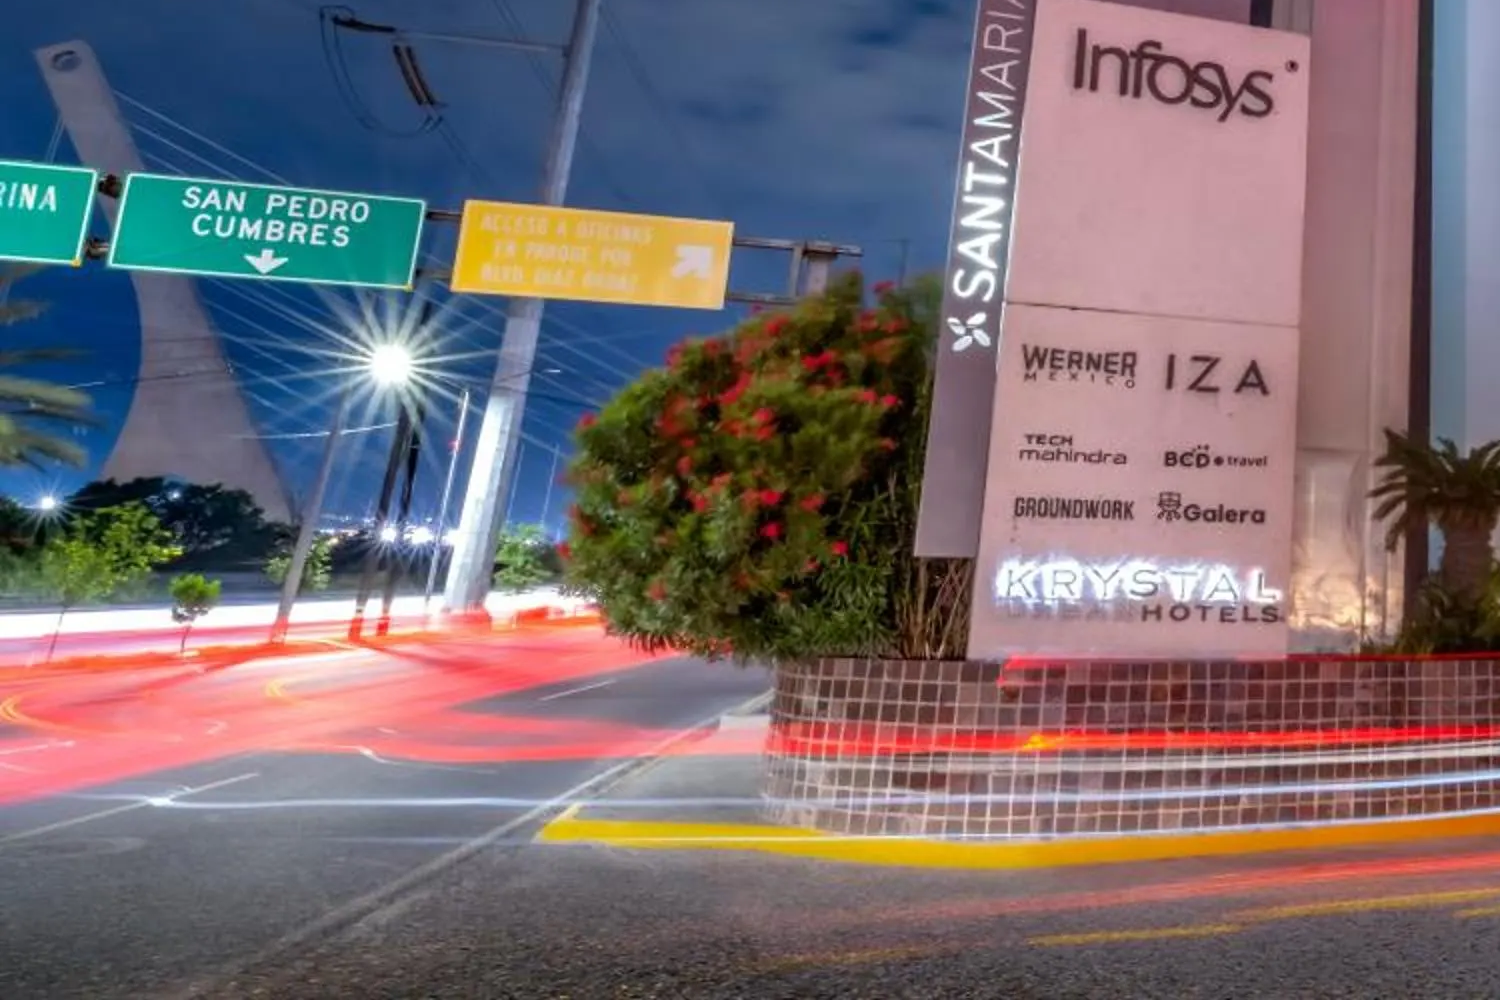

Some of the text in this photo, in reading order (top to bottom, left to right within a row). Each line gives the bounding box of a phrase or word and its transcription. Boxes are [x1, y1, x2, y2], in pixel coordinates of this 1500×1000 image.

[1073, 27, 1275, 123] Infosys
[182, 186, 371, 224] SAN PEDRO
[191, 213, 350, 248] CUMBRES
[1022, 344, 1138, 377] WERNER
[1165, 353, 1270, 395] IZA
[1024, 433, 1073, 447] TECH
[1018, 449, 1128, 466] mahindra
[1013, 496, 1135, 521] GROUNDWORK
[1183, 504, 1266, 524] Galera
[1005, 568, 1276, 600] KRYSTAL
